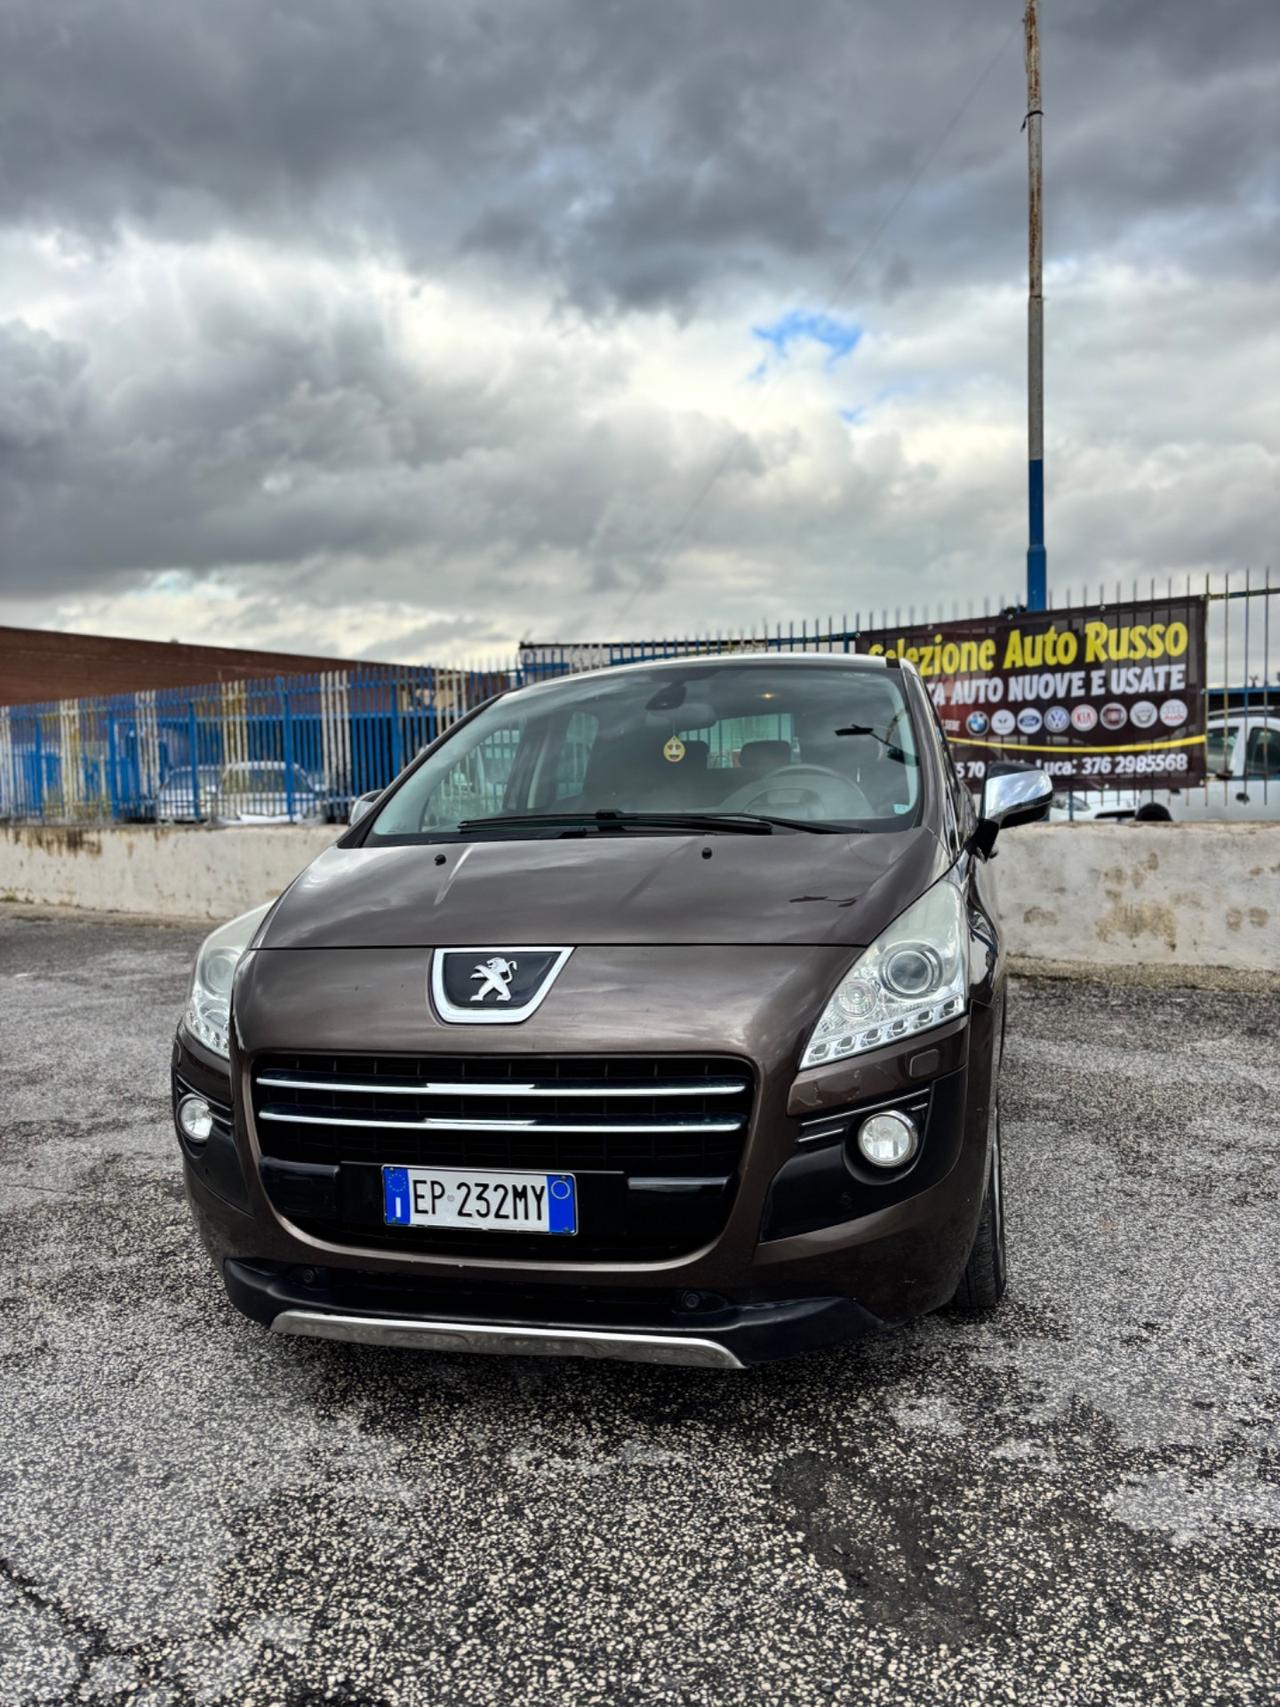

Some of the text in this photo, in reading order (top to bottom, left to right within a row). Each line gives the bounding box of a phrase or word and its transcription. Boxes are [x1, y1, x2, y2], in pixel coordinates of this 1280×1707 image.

[1003, 626, 1078, 670] Auto
[1084, 621, 1189, 664] Russo
[950, 677, 1004, 705] AUTO
[1008, 670, 1085, 702] NUOVE
[1091, 668, 1106, 696] E
[1111, 664, 1186, 694] USATE
[1082, 757, 1111, 774] 376
[1114, 754, 1188, 774] 2985568
[412, 1179, 546, 1221] EP 232MY
